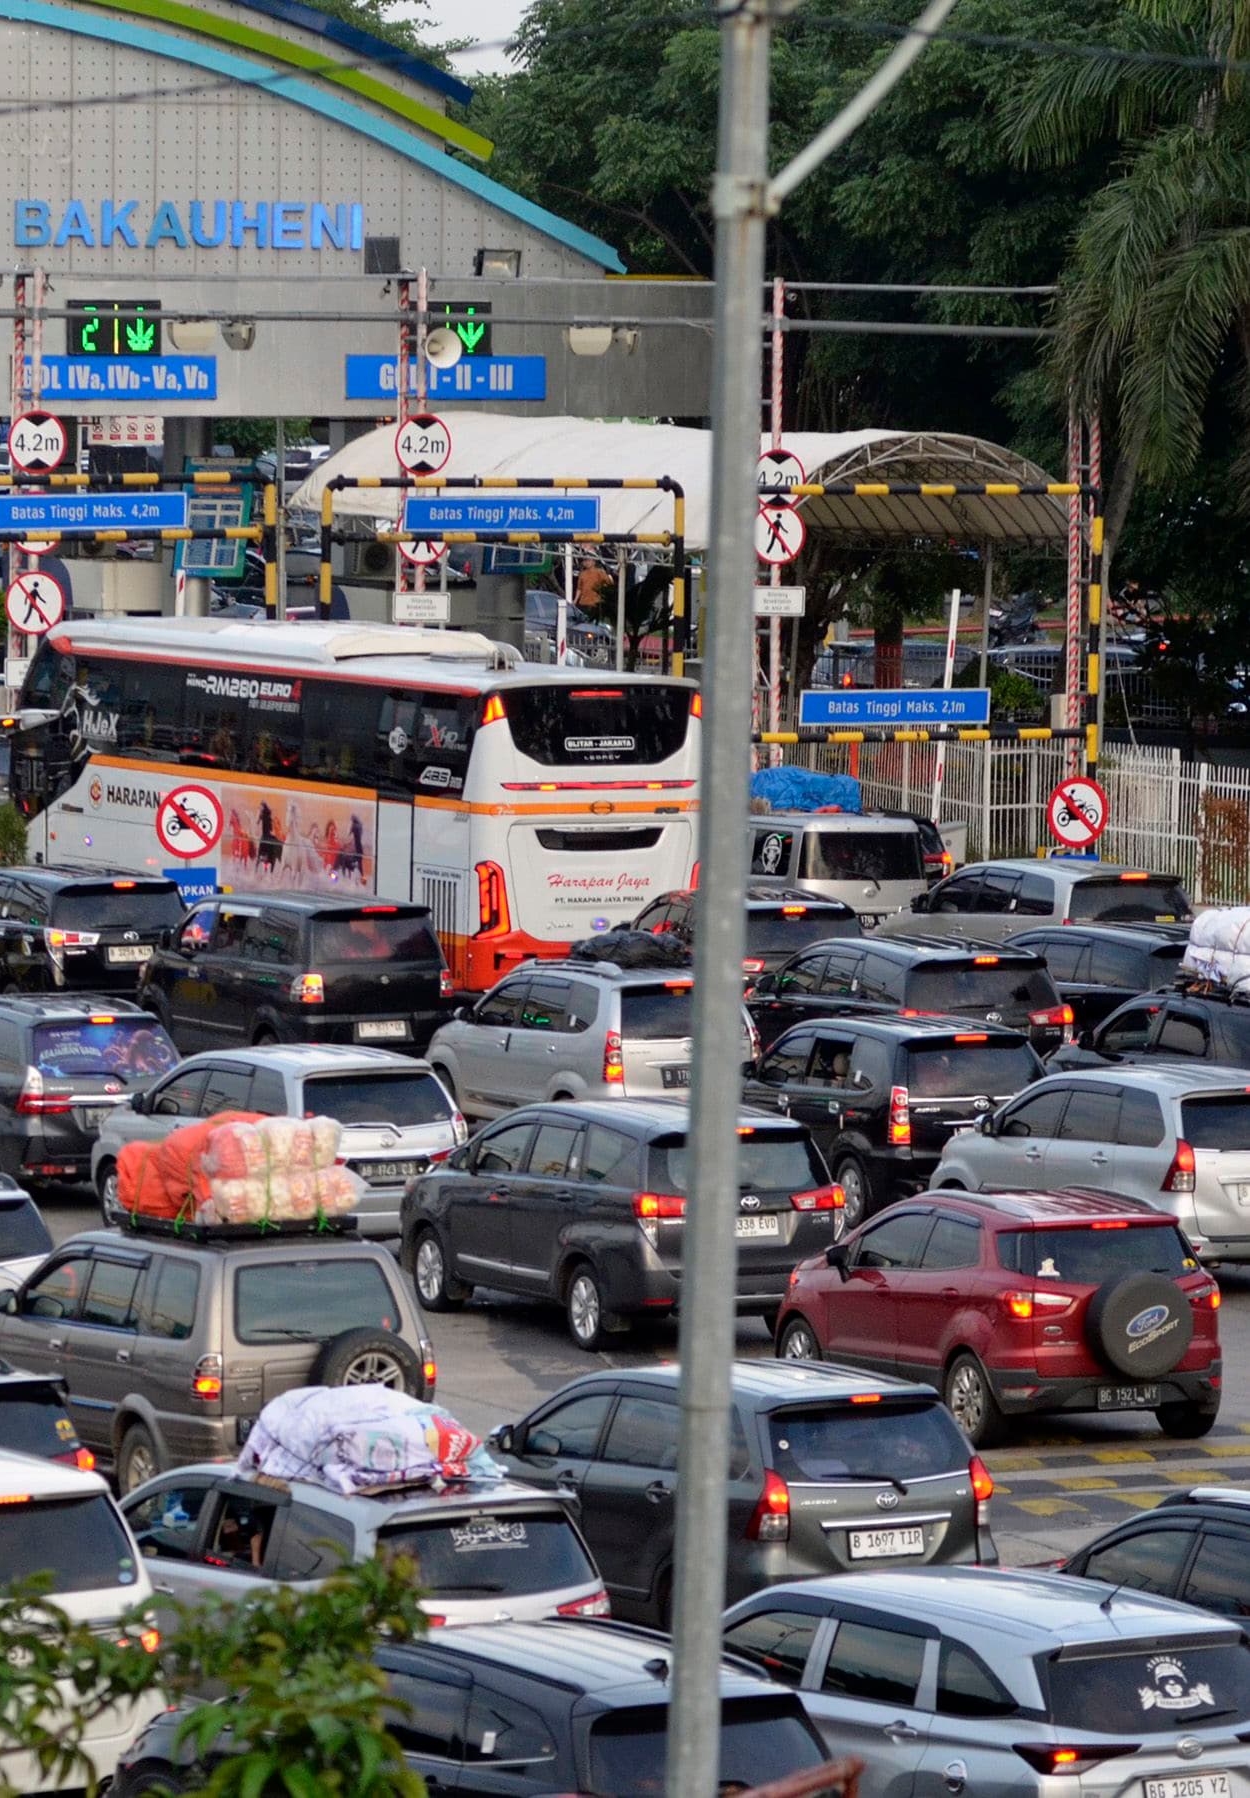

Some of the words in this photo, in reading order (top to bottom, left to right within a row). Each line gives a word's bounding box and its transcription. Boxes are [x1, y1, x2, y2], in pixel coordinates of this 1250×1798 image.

[13, 199, 363, 251] BAKAUHENI
[456, 365, 472, 391] II
[489, 365, 513, 391] III
[14, 433, 59, 452] 4.2m
[401, 435, 445, 454] 4.2m
[11, 505, 46, 520] Batas
[50, 504, 88, 522] Tinggi
[93, 504, 126, 519] Maks.
[130, 504, 160, 519] 4,2m
[429, 507, 462, 521] Batas
[468, 506, 504, 523] Tinggi
[508, 506, 541, 521] Maks.
[546, 506, 574, 522] 4,2m
[205, 675, 259, 699] RM280
[260, 681, 292, 698] EURO
[828, 700, 860, 714] Batas
[866, 700, 901, 717] Tinggi
[906, 700, 938, 714] Maks.
[941, 700, 966, 714] 2,1m
[599, 739, 632, 747] JAKARTA
[106, 785, 161, 808] HARAPAN
[547, 873, 614, 890] Harapan
[616, 872, 651, 891] Jaya
[853, 1535, 861, 1548] B
[867, 1531, 895, 1548] 1697
[899, 1530, 921, 1545] TIR
[1149, 1783, 1166, 1798] BG
[1172, 1779, 1204, 1798] 1205
[1210, 1777, 1227, 1794] YZ
